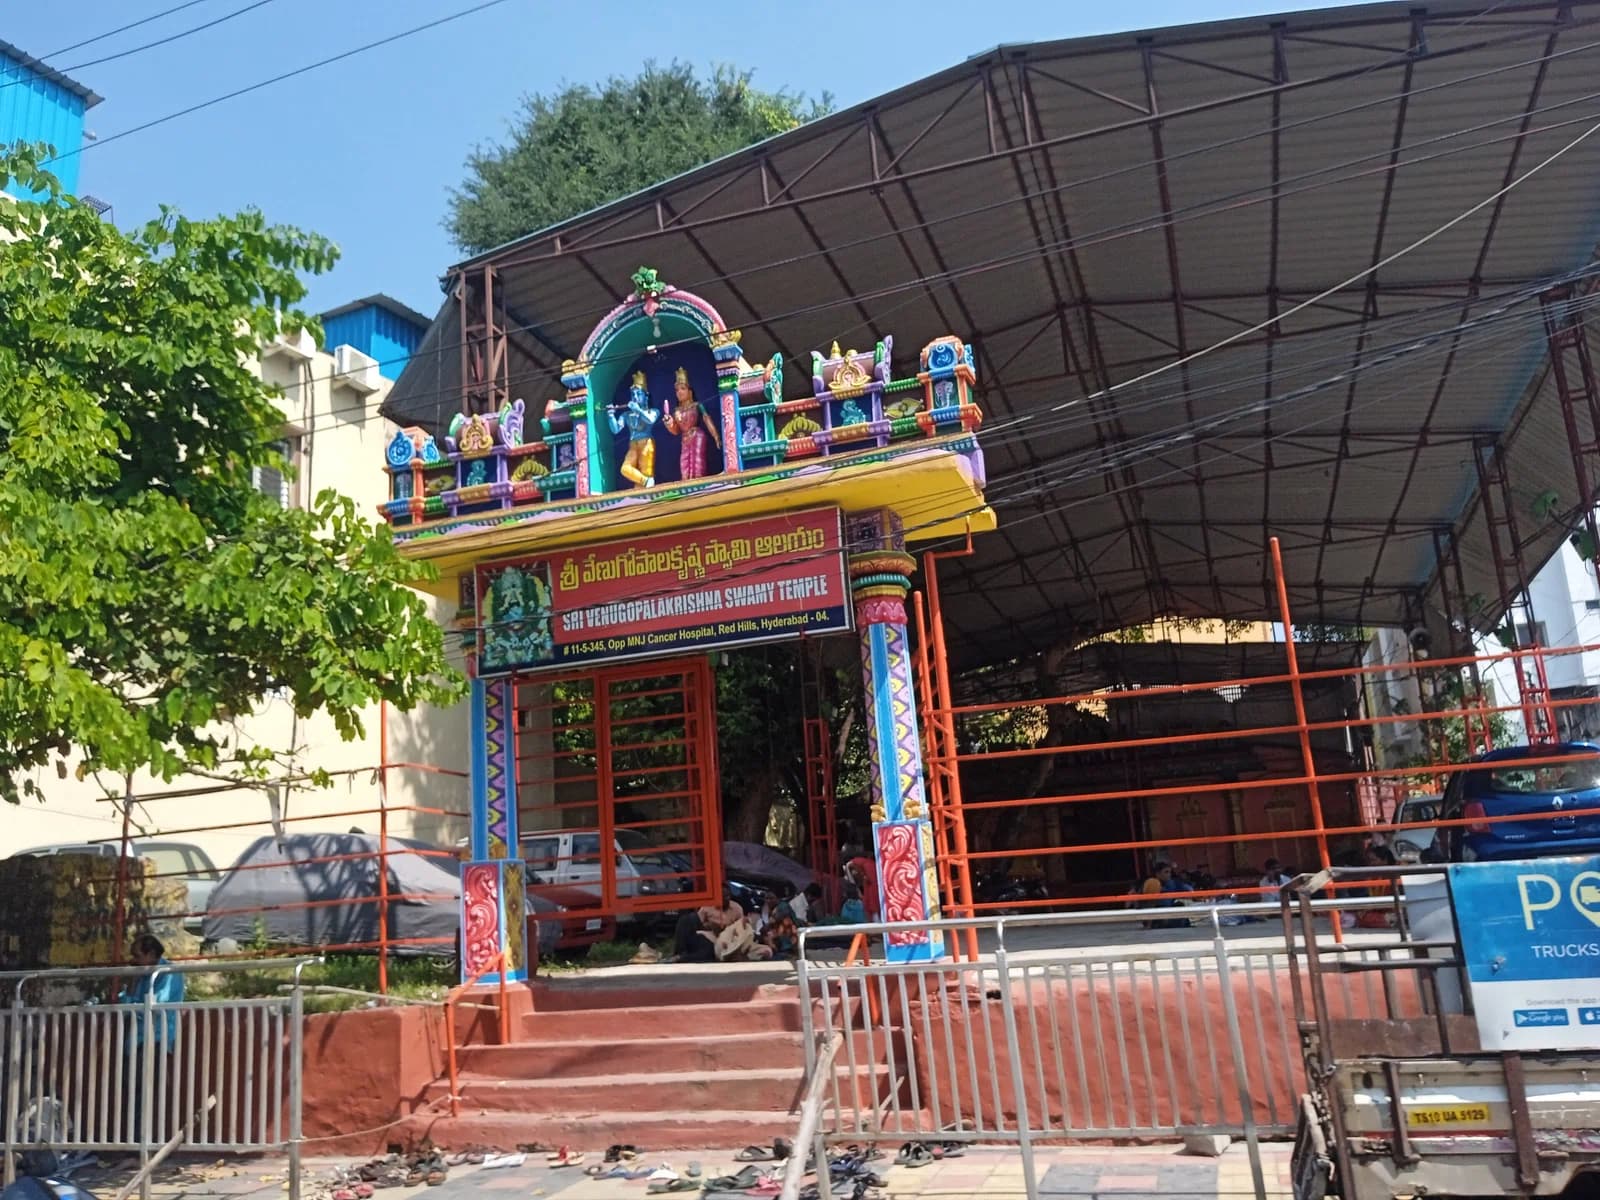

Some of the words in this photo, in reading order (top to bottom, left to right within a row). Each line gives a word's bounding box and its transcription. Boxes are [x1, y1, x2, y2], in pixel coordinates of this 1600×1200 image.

[560, 558, 579, 591] శ్రీ
[755, 526, 825, 558] ఆలయం
[563, 611, 584, 631] SRI
[586, 590, 722, 628] VENUGOPALAKRISHNA
[725, 582, 774, 609] SWAMY
[777, 575, 828, 601] TEMPLE
[563, 646, 570, 657] #
[571, 641, 607, 655] 11-5-345,
[608, 639, 625, 650] Opp
[627, 635, 646, 647] MNJ
[648, 632, 677, 644] Cancer
[679, 627, 716, 640] Hospital,
[718, 622, 736, 635] Red
[738, 620, 759, 632] Hills,
[761, 614, 809, 631] Hyderabad
[816, 611, 830, 622] 04.
[1530, 943, 1600, 958] TRUCKS
